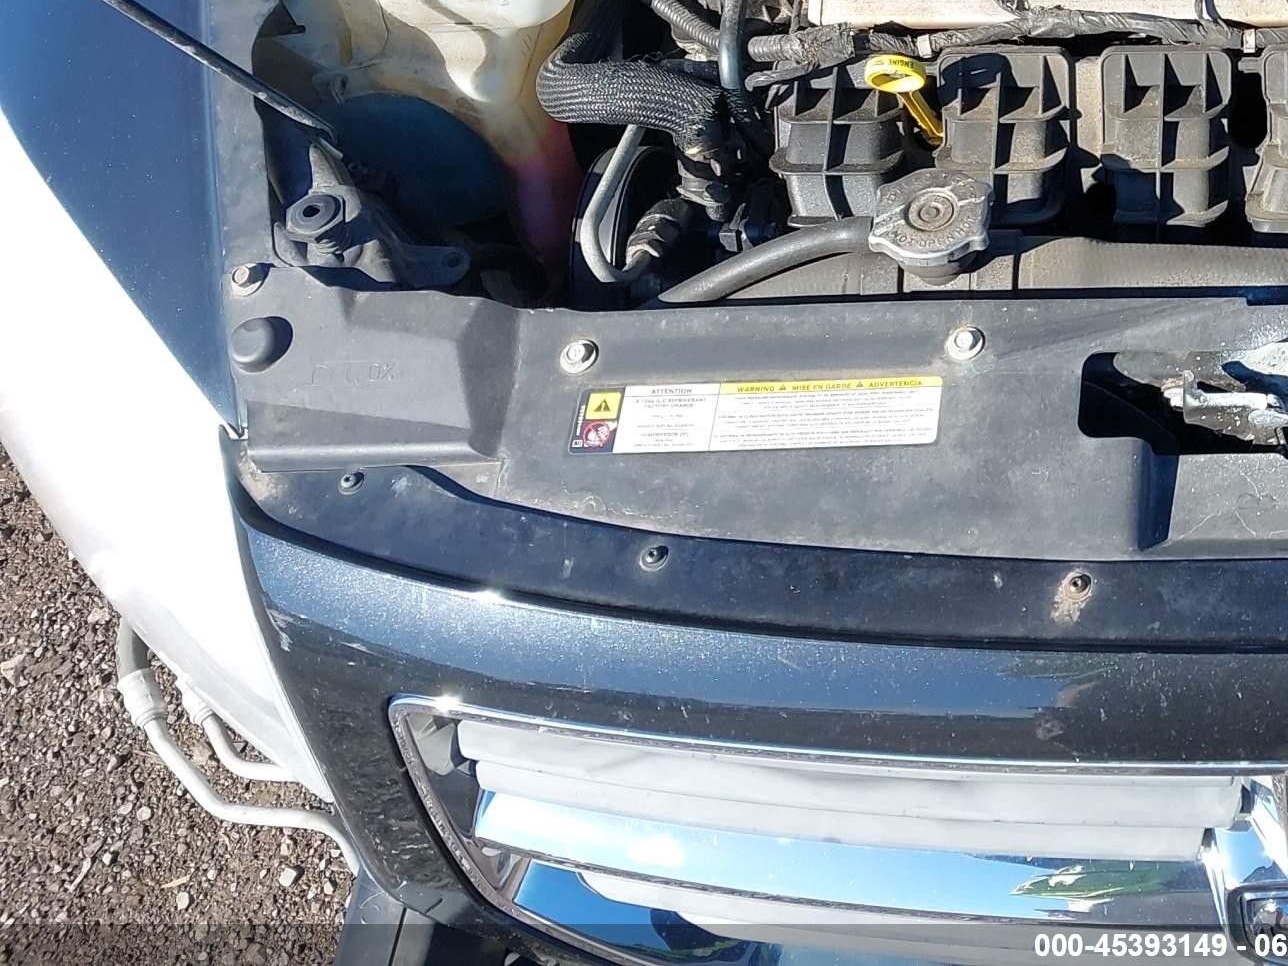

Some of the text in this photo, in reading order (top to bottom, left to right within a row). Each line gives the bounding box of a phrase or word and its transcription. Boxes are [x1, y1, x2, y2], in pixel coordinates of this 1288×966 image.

[888, 58, 914, 69] ENGINE
[737, 385, 775, 393] WARNING
[868, 380, 923, 388] ADVERTENCIA
